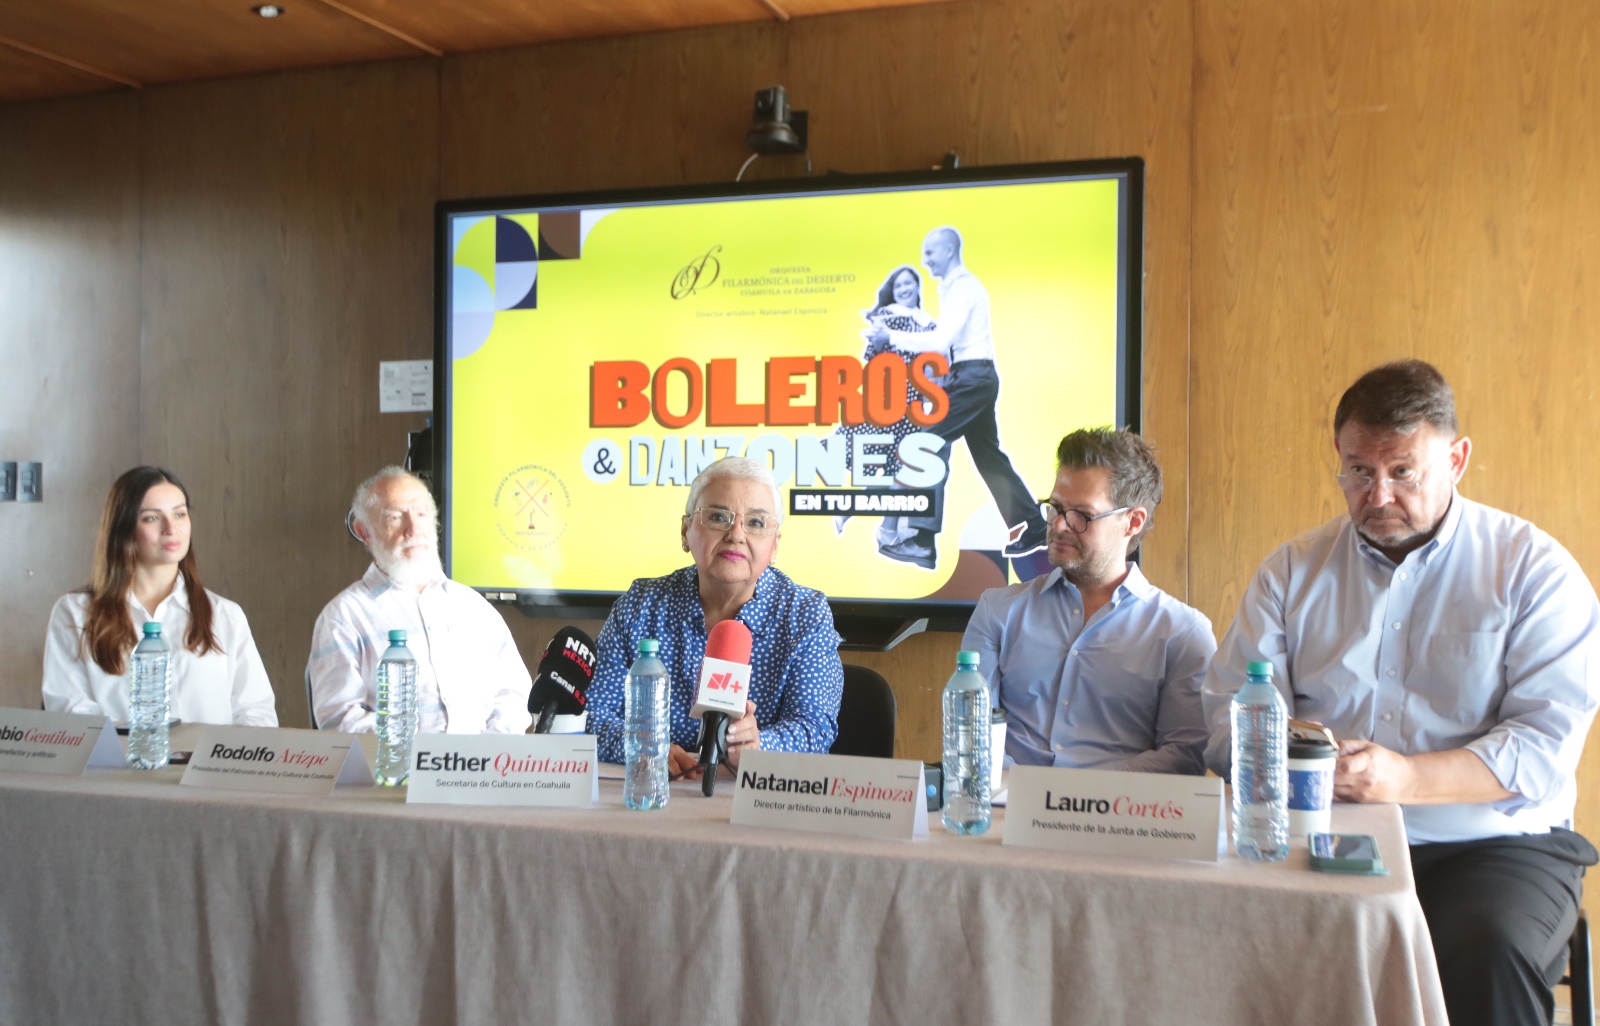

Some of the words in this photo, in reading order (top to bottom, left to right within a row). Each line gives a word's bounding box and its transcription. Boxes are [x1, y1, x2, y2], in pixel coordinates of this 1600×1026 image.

[722, 275, 790, 288] FILARMÓNICA
[806, 273, 856, 285] DESIERTO
[769, 266, 811, 275] ORQUESTA
[740, 288, 781, 297] COAHUILA
[794, 286, 837, 295] ZARAGOZA
[696, 310, 724, 319] Director
[760, 307, 793, 316] Natanael
[794, 307, 828, 318] Espinoza
[589, 352, 950, 429] BOLEROS
[593, 447, 616, 475] &
[795, 494, 822, 511] EN
[824, 494, 852, 511] TU
[855, 495, 930, 512] BARRIO
[565, 636, 596, 668] NRT
[550, 671, 576, 694] Canal
[0, 725, 24, 741] bio
[24, 727, 86, 746] Gentiloni
[210, 743, 275, 763] Rodolfo
[275, 748, 329, 769] Arizpe
[416, 751, 491, 772] Esther
[493, 752, 589, 777] Quintana
[192, 764, 221, 773] Presidente
[230, 767, 257, 776] Patronato
[283, 771, 303, 779] Cultura
[479, 780, 490, 788] de
[491, 780, 522, 789] Cultura
[535, 780, 571, 789] Coahuila
[741, 771, 829, 796] Natanael
[830, 777, 914, 803] Espinoza
[754, 799, 786, 810] Director
[787, 803, 821, 814] artístico
[822, 806, 833, 815] de
[834, 806, 842, 815] la
[843, 807, 891, 820] Filarmónica
[1045, 790, 1110, 814] Lauro
[1112, 795, 1184, 819] Cortés
[1032, 819, 1081, 833] Presidente
[1083, 823, 1096, 833] de
[1097, 824, 1106, 834] la
[1107, 825, 1136, 836] Junta
[1136, 827, 1149, 837] de
[1150, 828, 1197, 841] Gobierno
